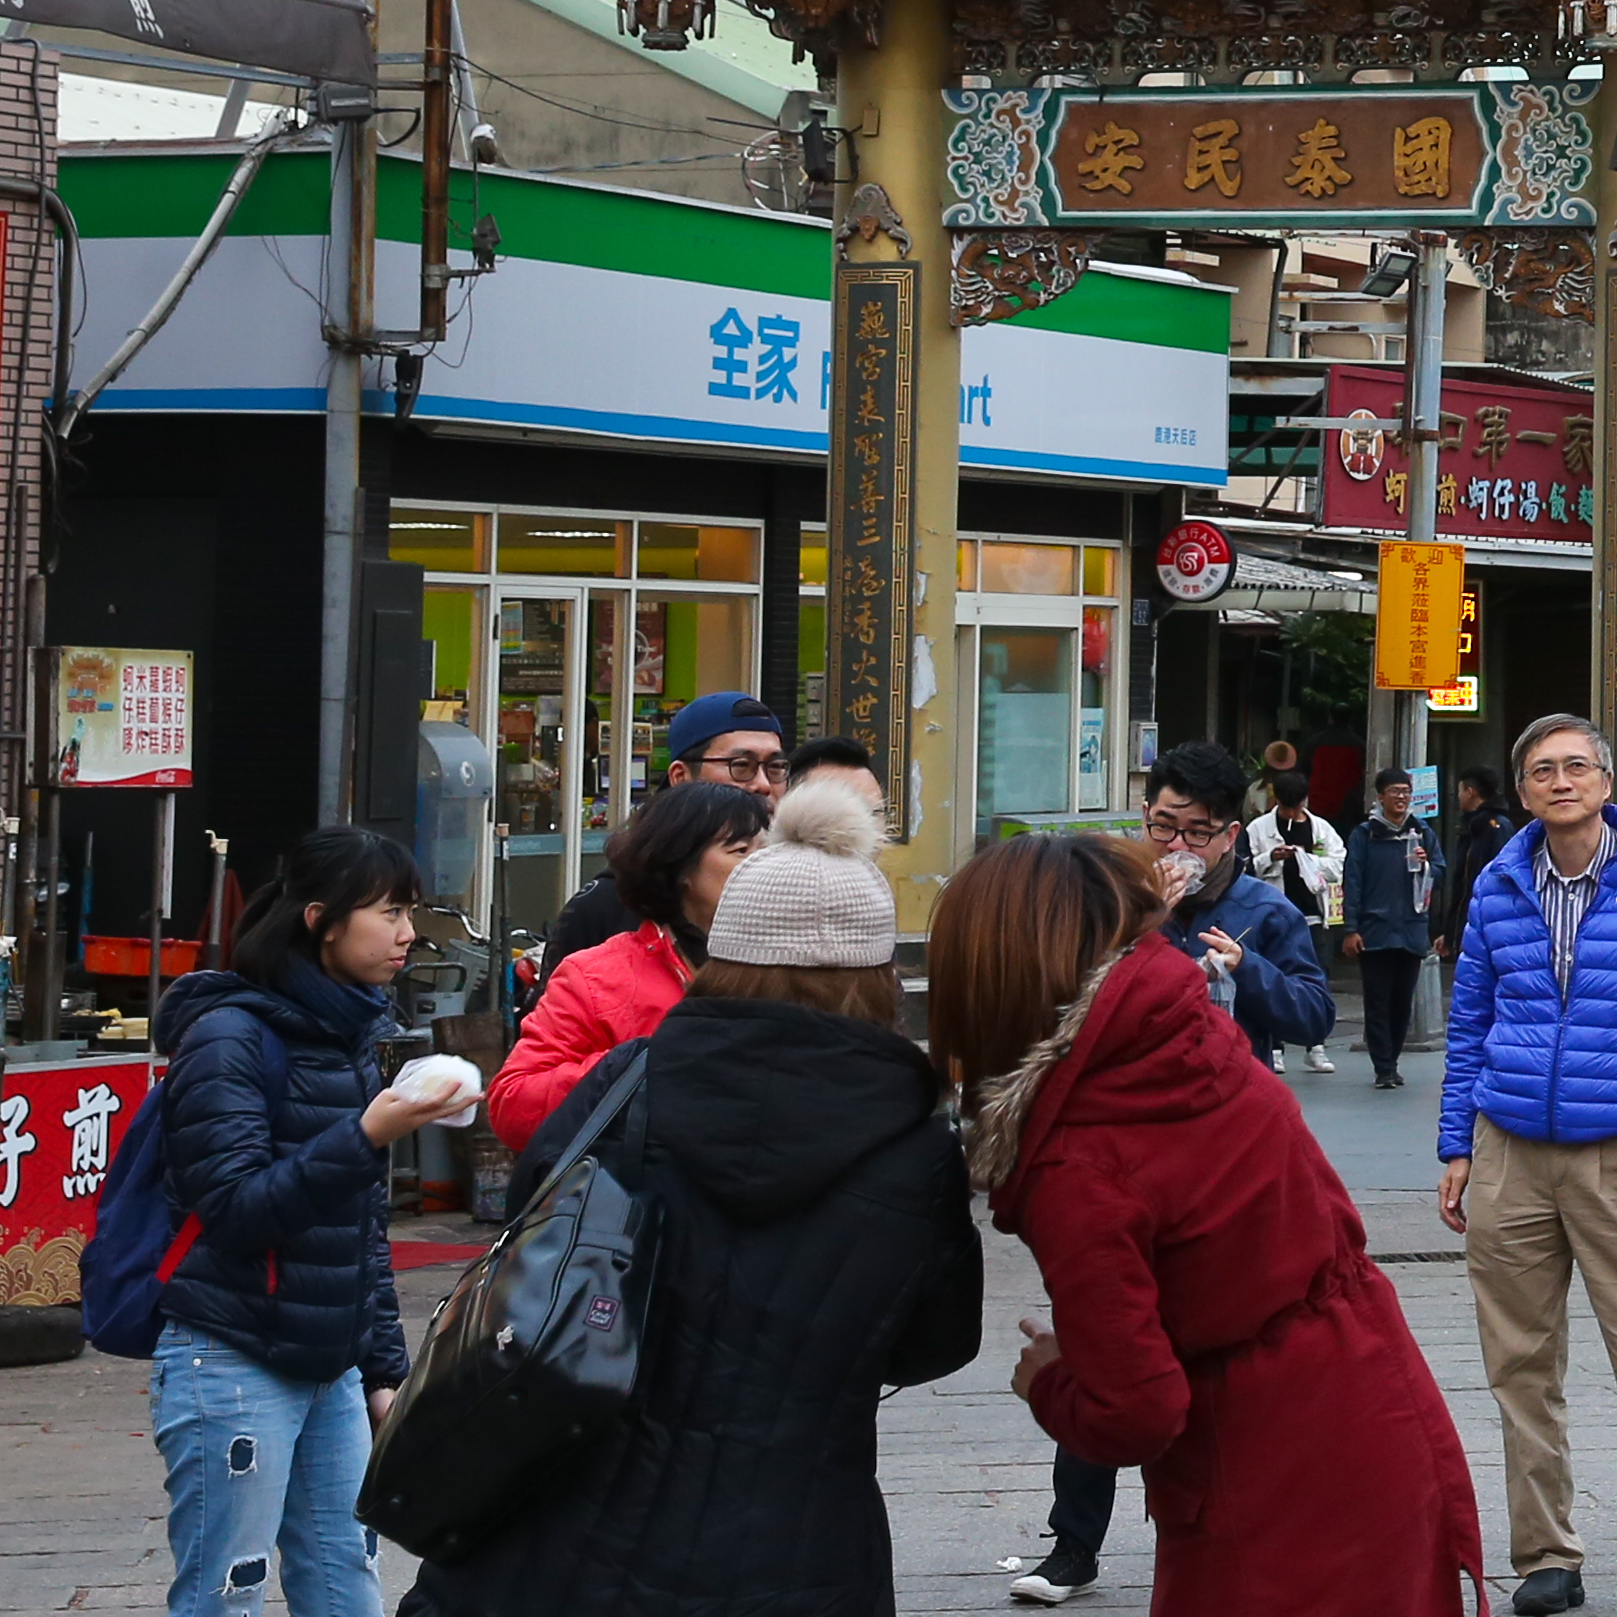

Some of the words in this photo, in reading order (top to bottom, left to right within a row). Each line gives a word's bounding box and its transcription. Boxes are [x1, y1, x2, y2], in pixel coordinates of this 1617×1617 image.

[708, 307, 800, 404] 全家
[1401, 547, 1444, 565] 歡迎
[1409, 562, 1430, 685] 各界蒞臨本宮進香
